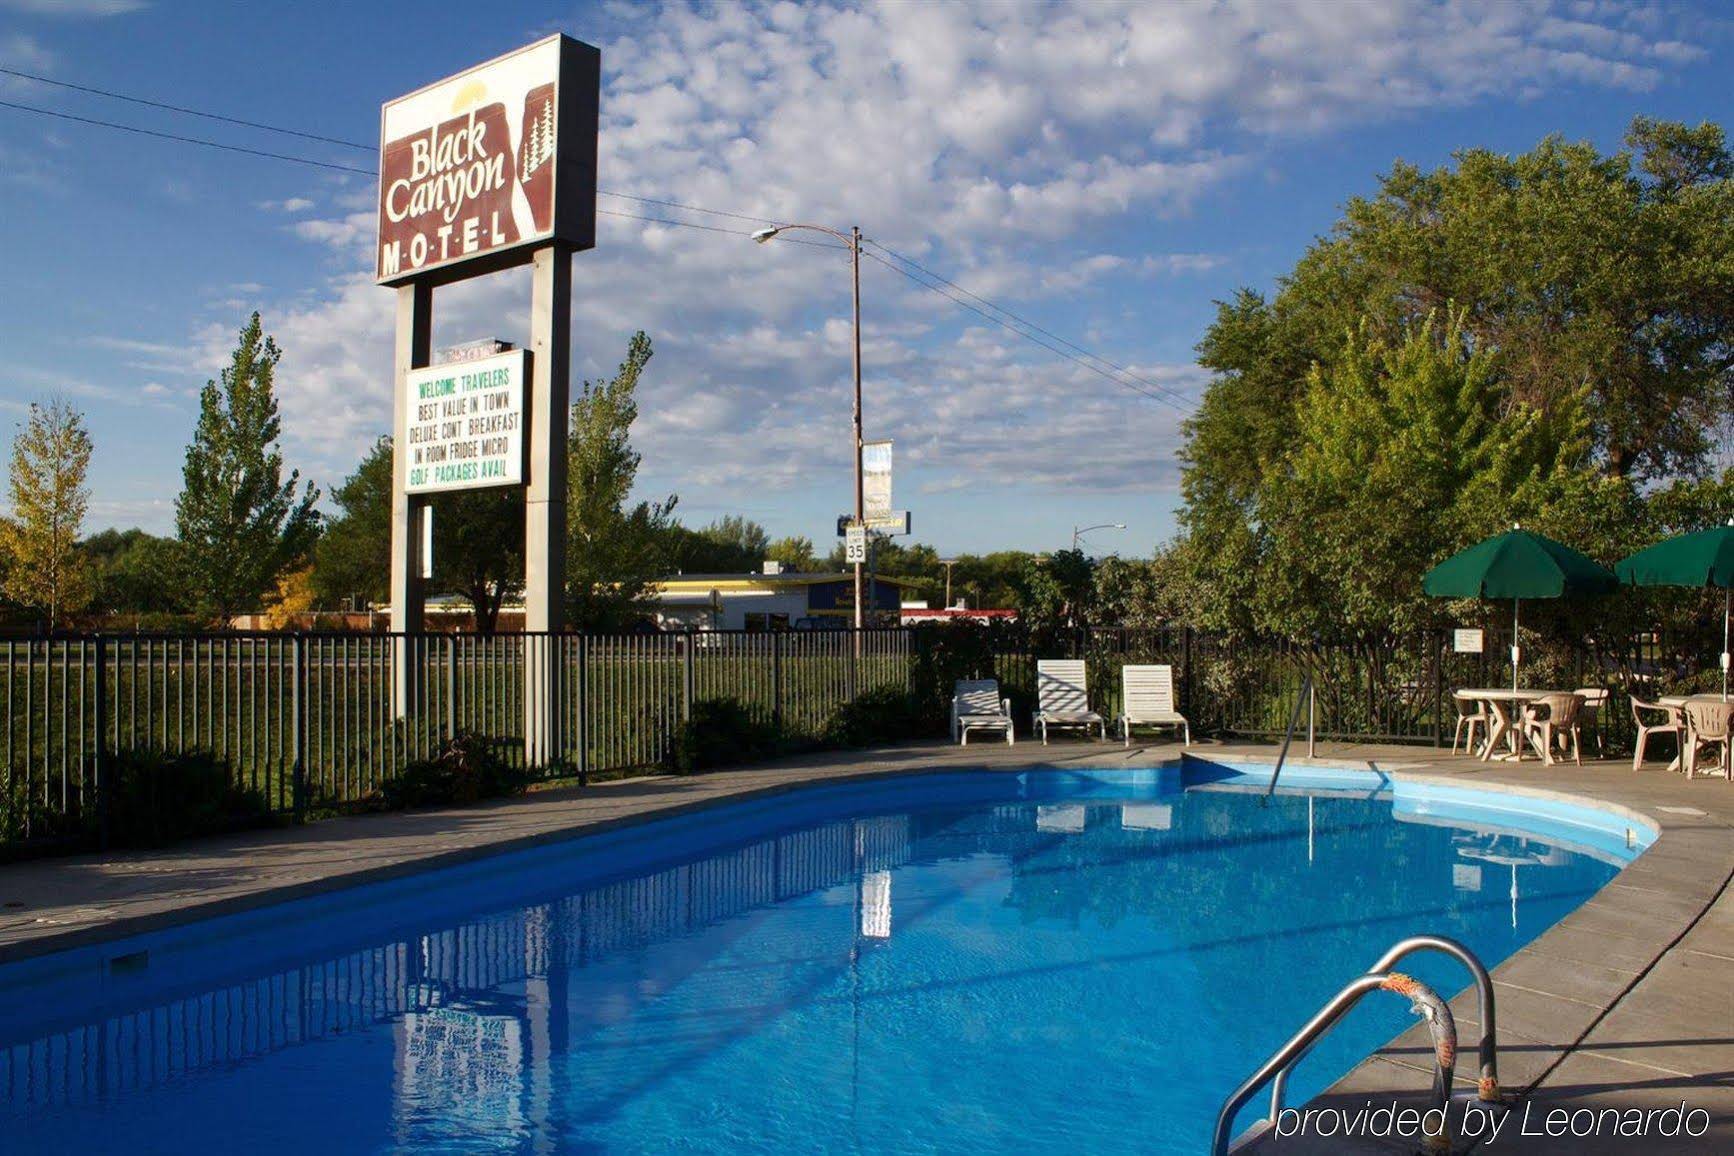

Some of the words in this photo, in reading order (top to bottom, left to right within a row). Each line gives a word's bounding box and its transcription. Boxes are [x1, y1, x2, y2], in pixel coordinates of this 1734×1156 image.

[410, 112, 487, 182] Black
[386, 153, 505, 223] Canyon
[419, 378, 456, 399] WELCOME
[461, 368, 509, 393] TRAVELERS
[418, 403, 438, 421] BEST
[442, 398, 466, 417] VALUE
[470, 396, 478, 413] IN
[484, 392, 509, 411] TOWN
[410, 424, 437, 444] DELUXE
[442, 421, 462, 439] CONT
[469, 412, 519, 435] BREAKFAST
[415, 448, 422, 464] IN
[426, 445, 446, 462] ROOM
[450, 440, 478, 460] FRIDGE
[482, 437, 508, 456] MICRO
[411, 467, 429, 486] GOLF
[435, 463, 478, 482] PACKAGES
[481, 459, 507, 478] AVAIL
[848, 545, 863, 558] 35
